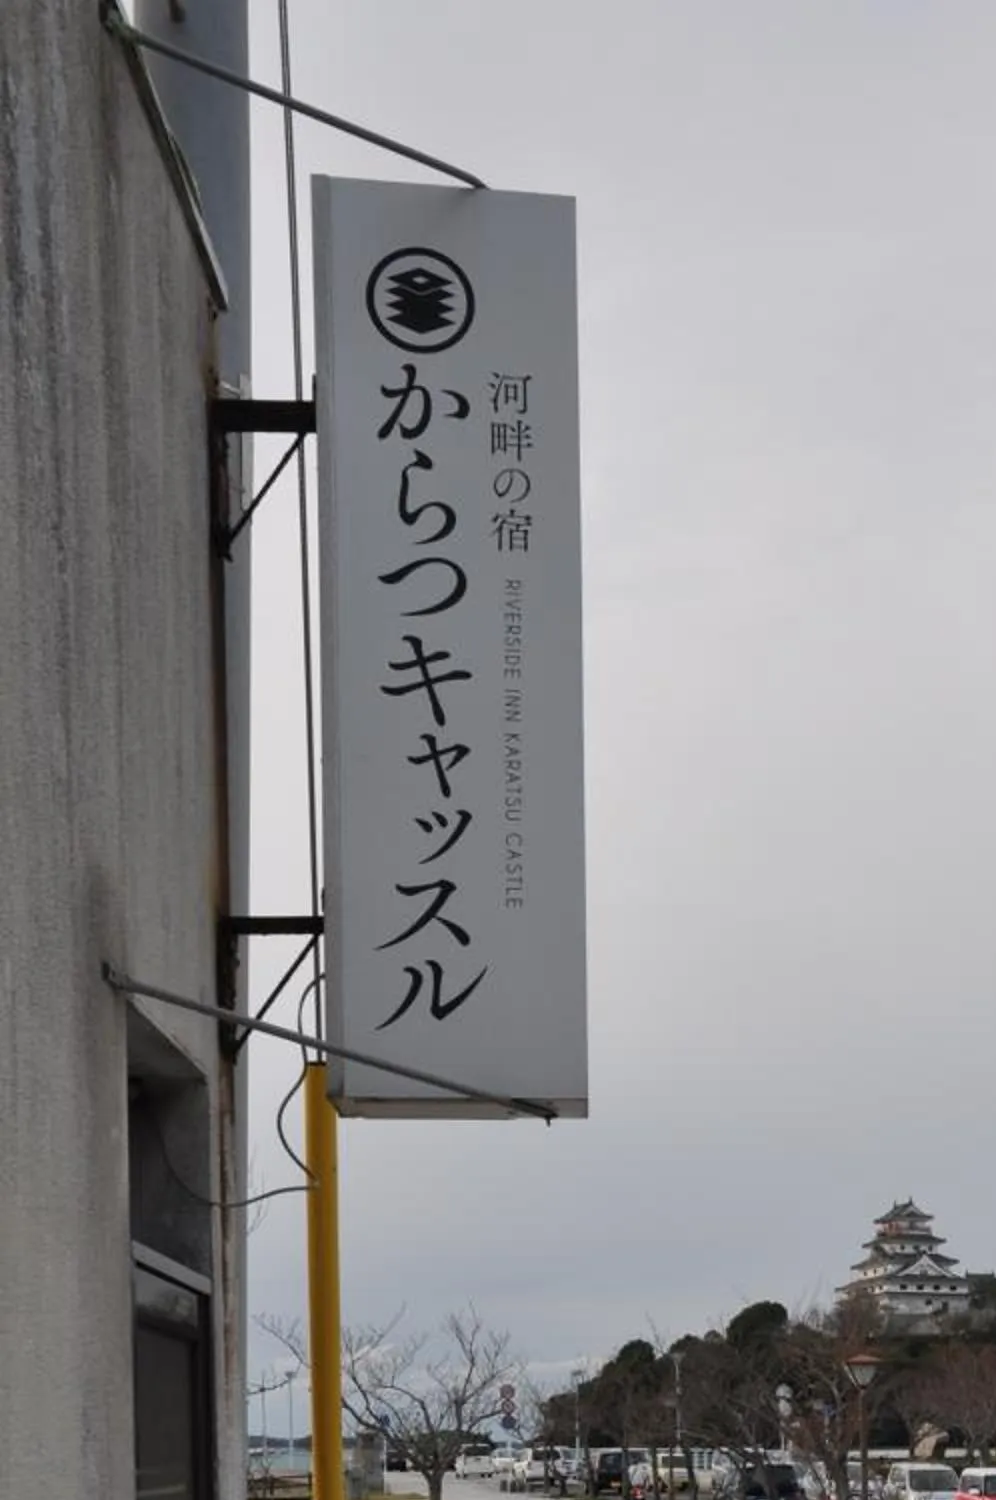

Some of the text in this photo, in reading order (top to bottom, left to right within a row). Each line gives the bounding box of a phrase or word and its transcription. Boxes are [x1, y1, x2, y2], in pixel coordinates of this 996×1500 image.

[488, 372, 533, 552] 河畔の宿
[374, 363, 489, 1031] からつキャッスル
[504, 578, 523, 909] RIVERSIDE INN KARATSU CASTLE
